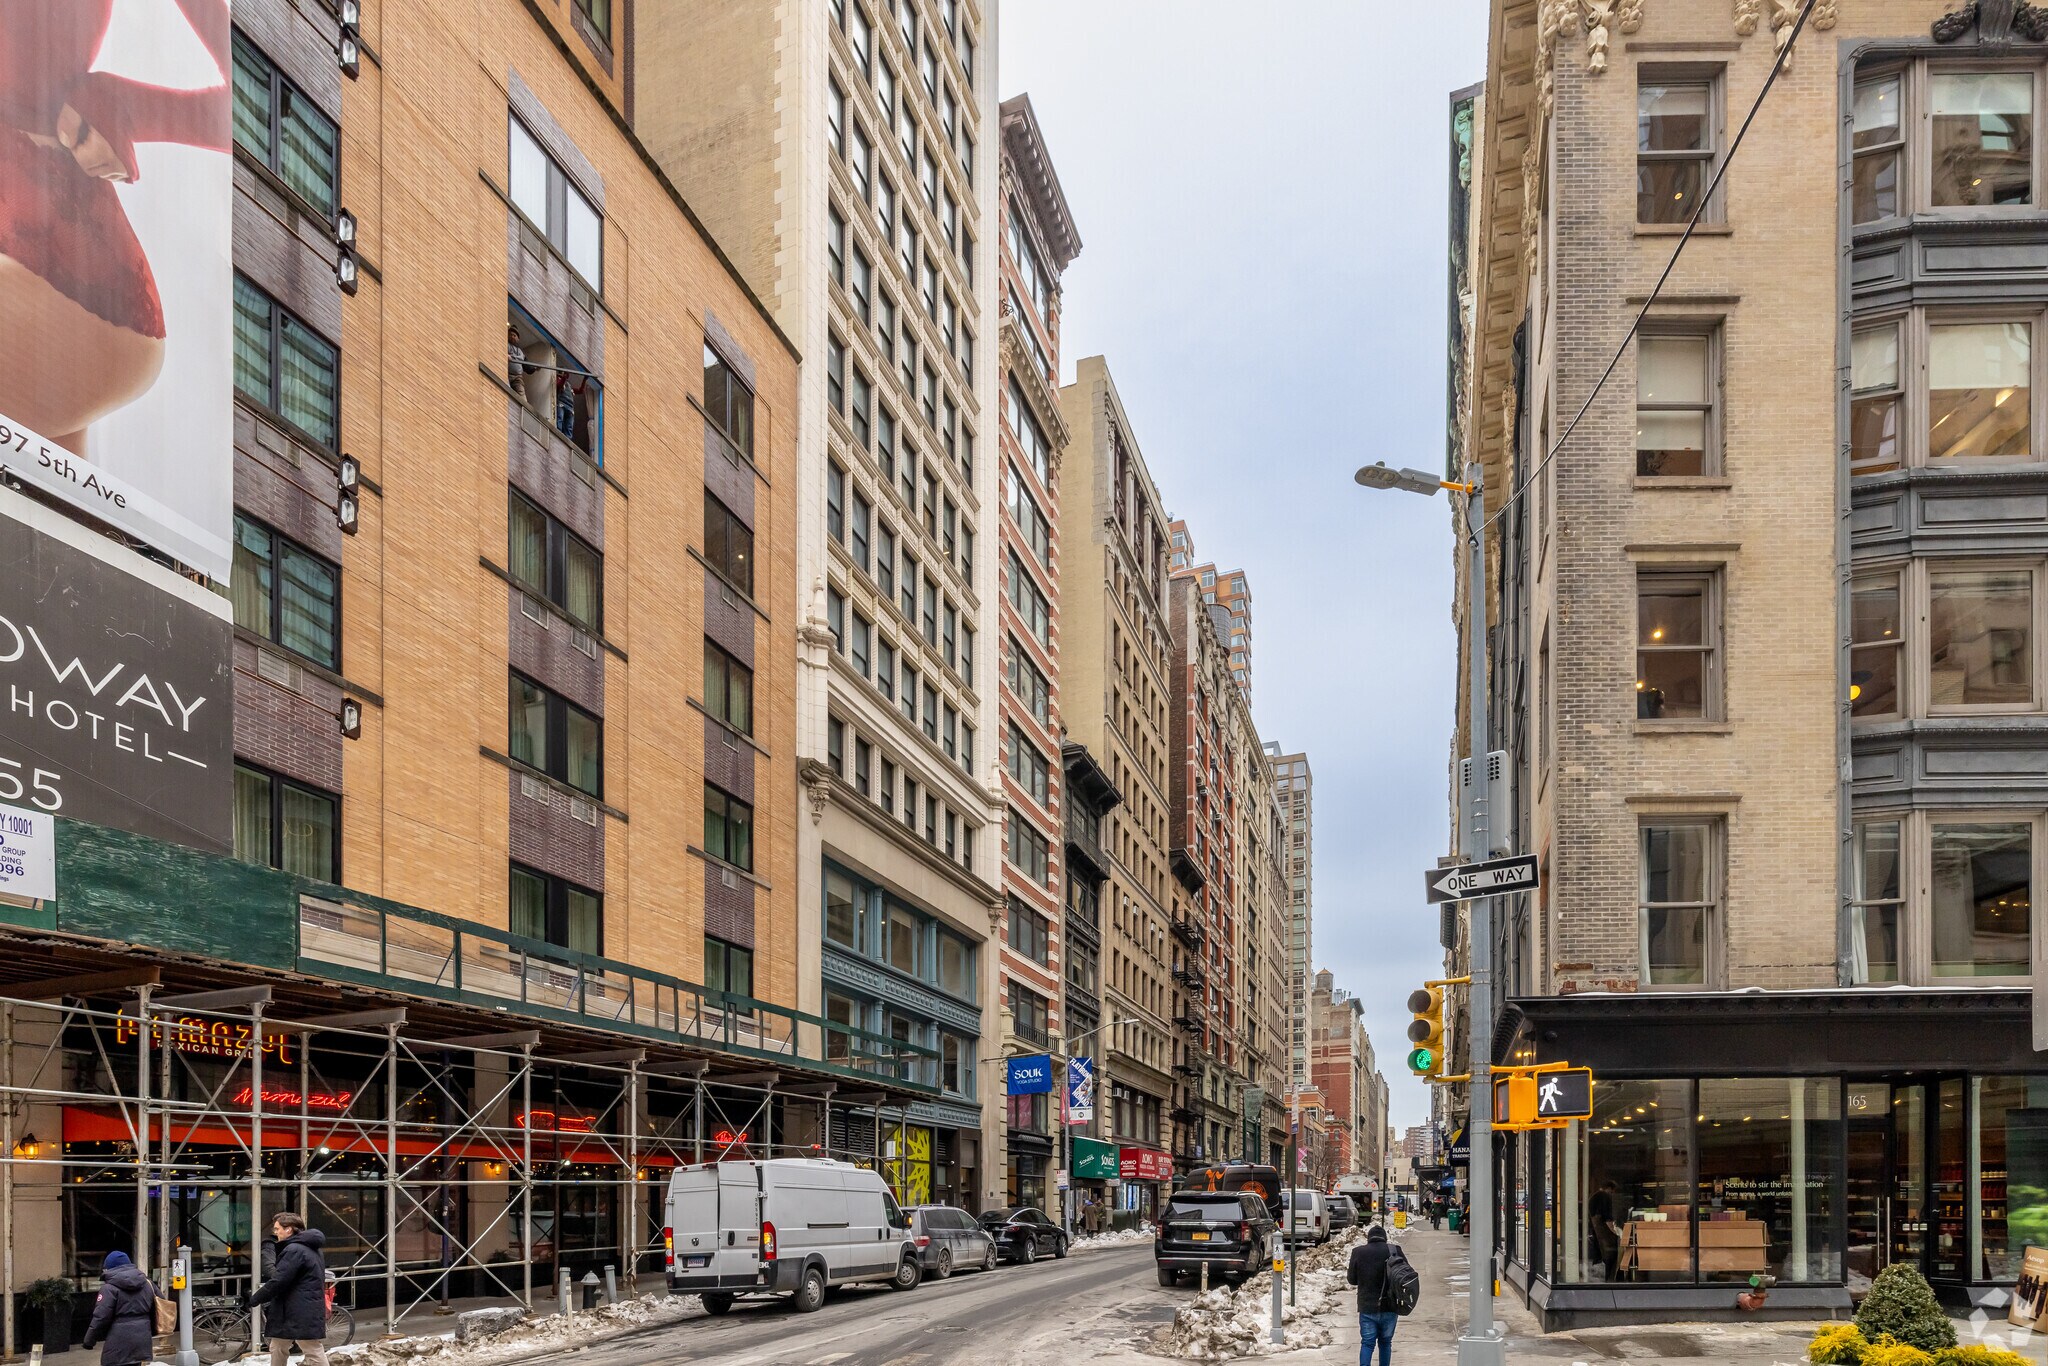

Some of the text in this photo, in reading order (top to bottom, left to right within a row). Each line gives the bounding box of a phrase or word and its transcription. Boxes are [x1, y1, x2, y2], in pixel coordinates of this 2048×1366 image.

[38, 446, 77, 483] 5th
[82, 473, 127, 509] Ave
[11, 684, 163, 763] HOTEL
[9, 815, 33, 836] 10001
[2, 846, 26, 857] GROUP
[1448, 867, 1526, 890] ONE WAY
[157, 1040, 219, 1055] XICAN
[1014, 1068, 1044, 1080] SOUK
[1848, 1095, 1867, 1107] 165
[1725, 1180, 1748, 1189] Scents
[1758, 1180, 1768, 1188] stir
[1770, 1180, 1782, 1188] the
[1783, 1180, 1824, 1189] imation
[2026, 1254, 2045, 1264] Aesop
